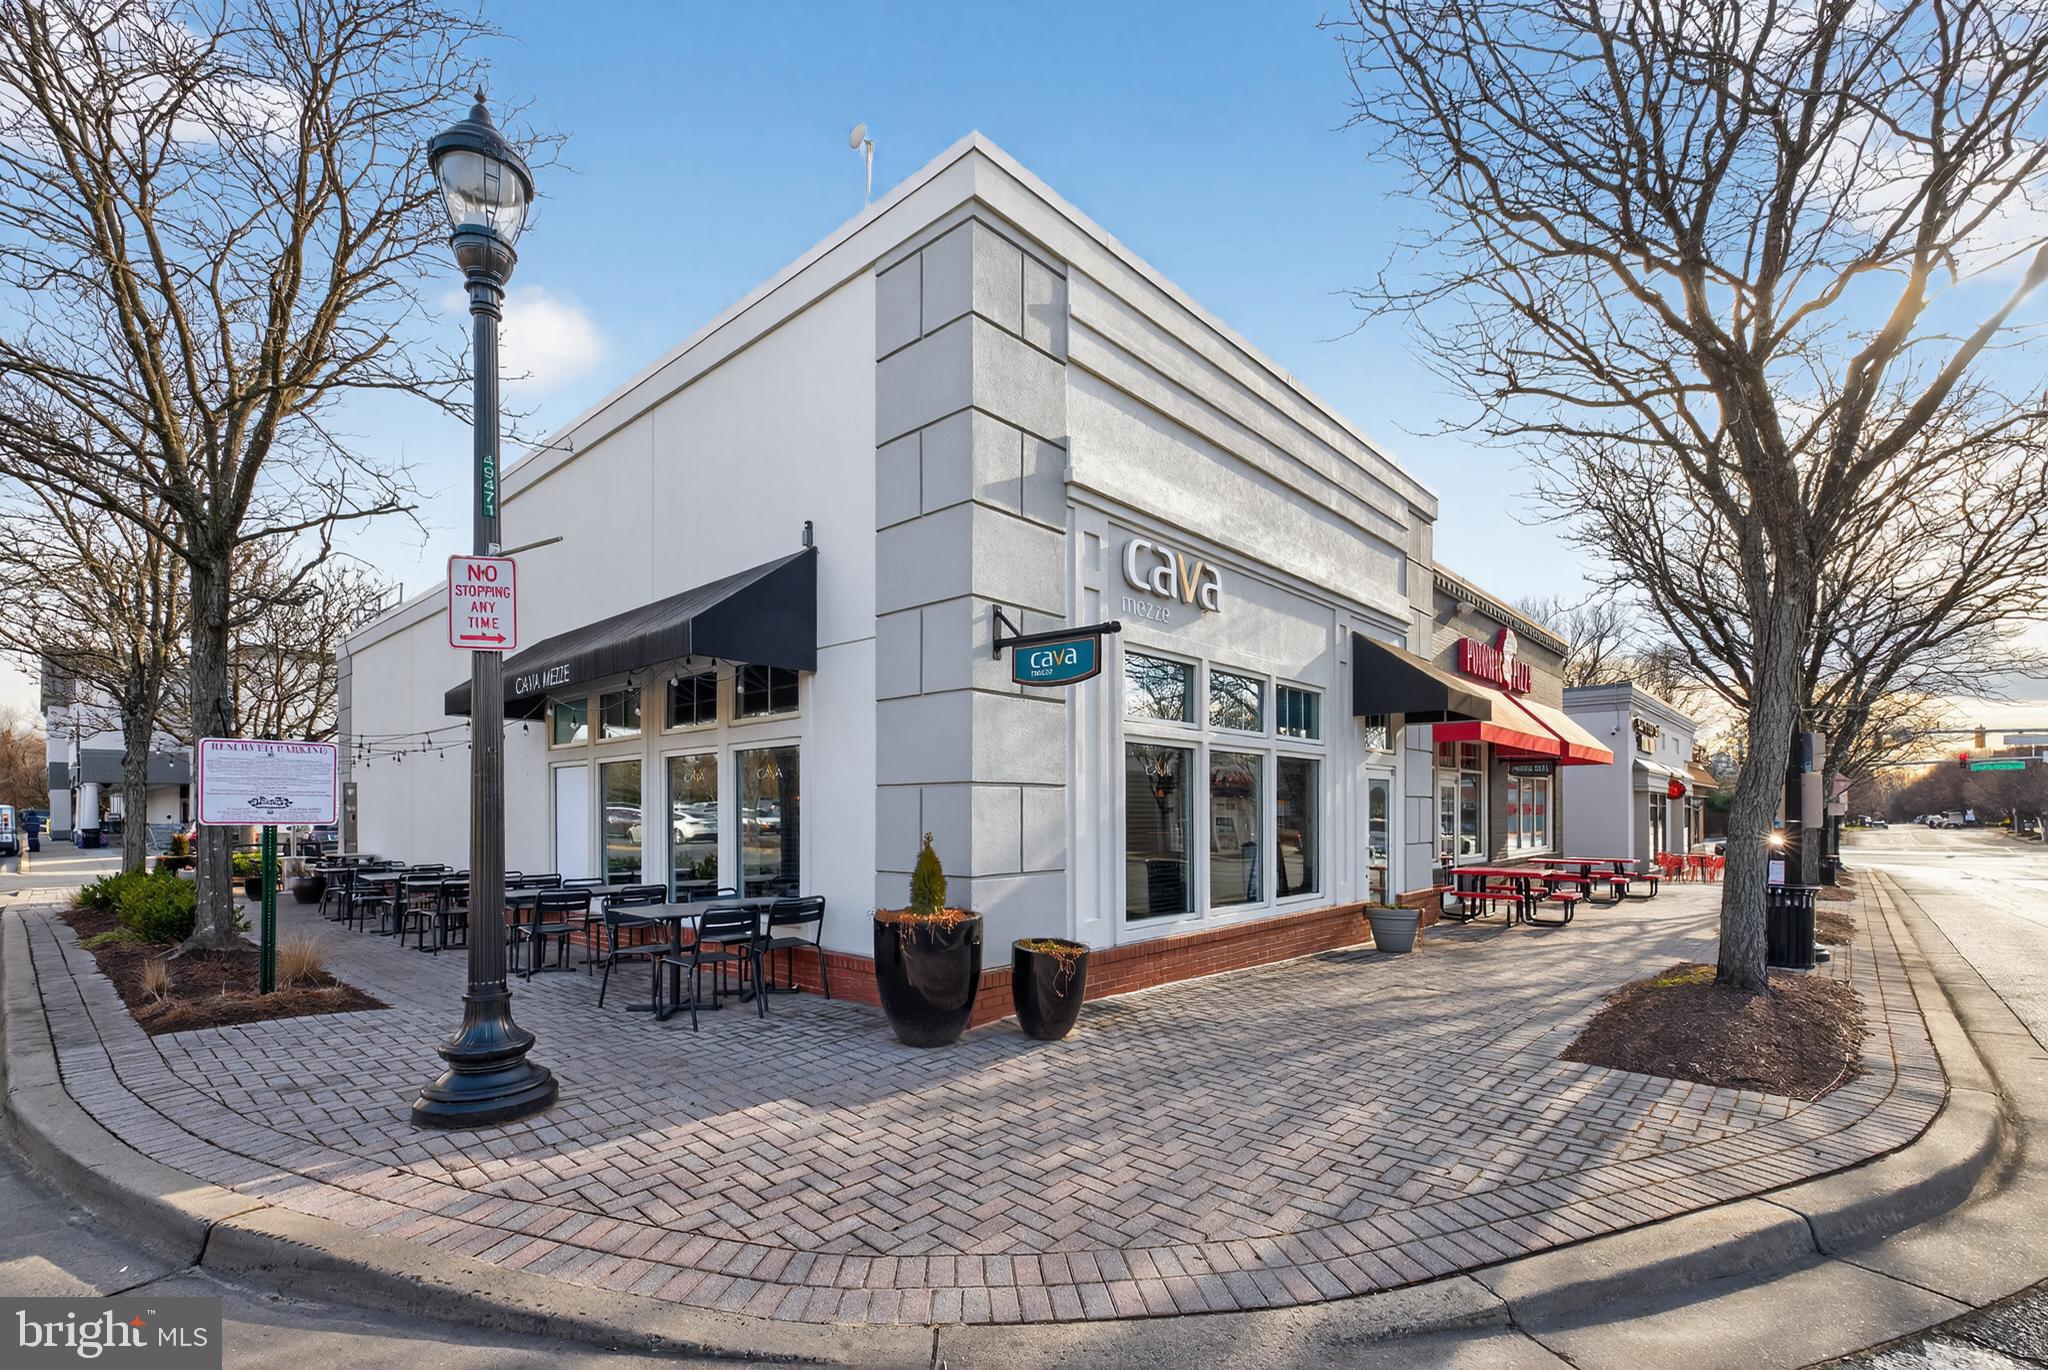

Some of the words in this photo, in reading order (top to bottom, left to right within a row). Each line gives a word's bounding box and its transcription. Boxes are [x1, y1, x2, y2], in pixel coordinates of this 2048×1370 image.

[467, 563, 498, 583] NO
[1122, 538, 1223, 613] cava
[455, 584, 511, 599] STOPPING
[470, 600, 496, 614] ANY
[1122, 595, 1171, 625] mezze
[467, 616, 500, 630] TIME
[1030, 647, 1078, 669] cava
[515, 673, 541, 695] CAVA
[542, 663, 570, 689] MEZZE
